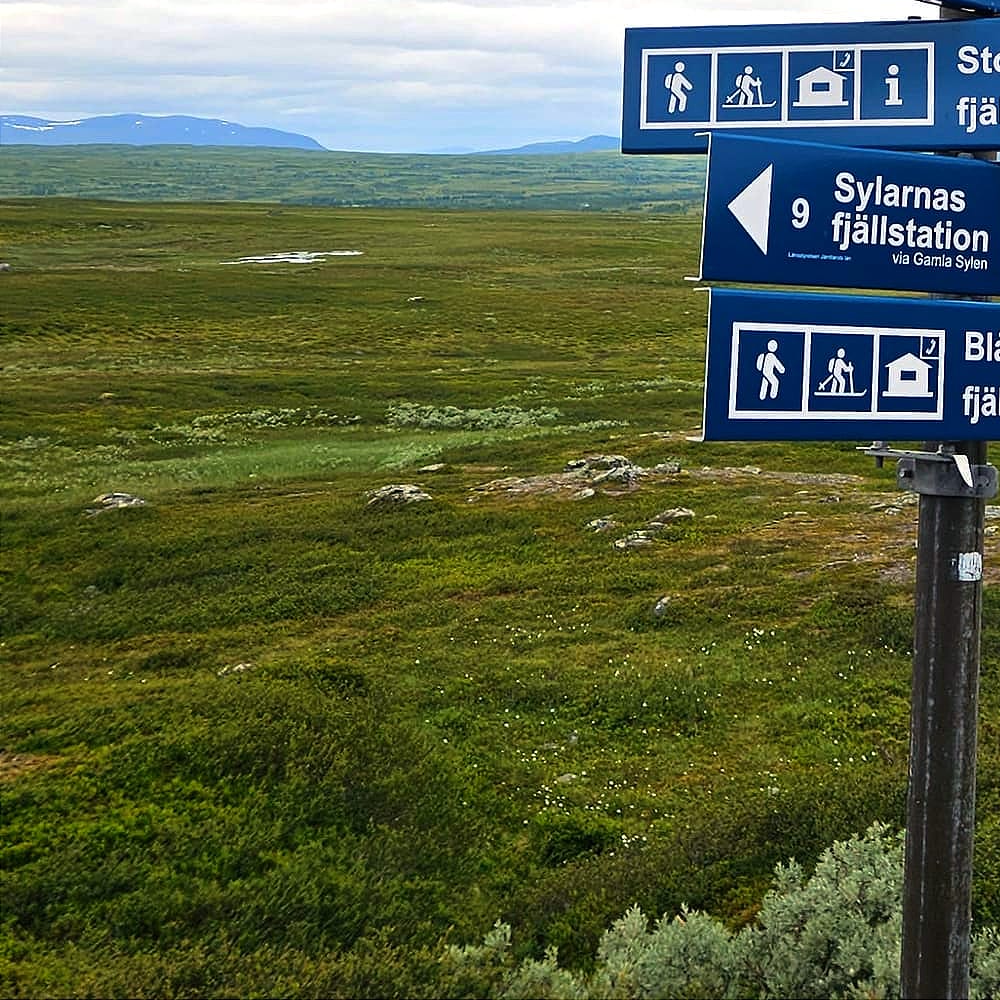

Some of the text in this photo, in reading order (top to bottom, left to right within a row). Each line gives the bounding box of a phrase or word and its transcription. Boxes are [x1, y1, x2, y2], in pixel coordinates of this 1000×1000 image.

[834, 171, 967, 213] Sylarnas
[791, 197, 810, 229] 9
[831, 210, 990, 253] fjällstation
[892, 250, 988, 272] via Gamla Sylen
